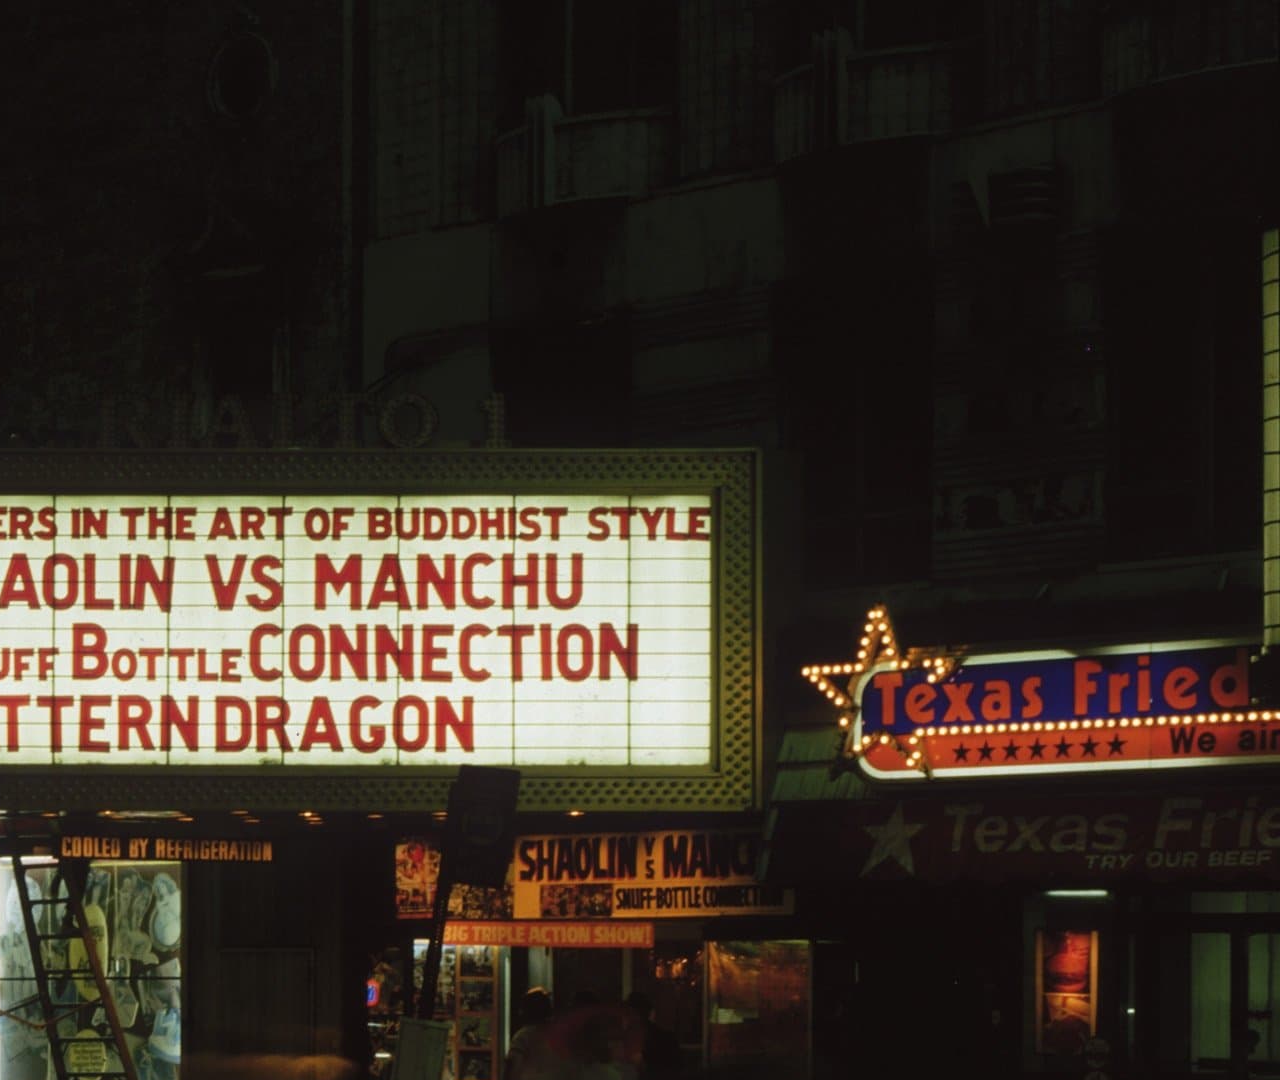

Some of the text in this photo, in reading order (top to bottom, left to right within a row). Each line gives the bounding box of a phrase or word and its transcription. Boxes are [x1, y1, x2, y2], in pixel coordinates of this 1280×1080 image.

[71, 507, 107, 540] IN
[120, 507, 195, 540] THE
[209, 507, 292, 540] ART
[304, 507, 350, 540] OF
[368, 506, 563, 541] BUDDHIST
[587, 506, 711, 541] STYLE
[205, 553, 283, 611] VS
[314, 552, 584, 611] MANCHU
[71, 622, 242, 682] BOTTLE
[248, 622, 639, 683] CONNECTION
[874, 649, 1250, 725] Texas Fried
[215, 695, 475, 754] DRAGON
[1169, 726, 1216, 754] We
[62, 837, 274, 862] COOLED BY REFRIGERATION
[945, 803, 1129, 854] Texas
[519, 835, 637, 881] SHAOLIN
[1085, 849, 1271, 870] TRY OUR BEEF
[443, 926, 652, 946] BIG TRIPLE ACTION SHOW!
